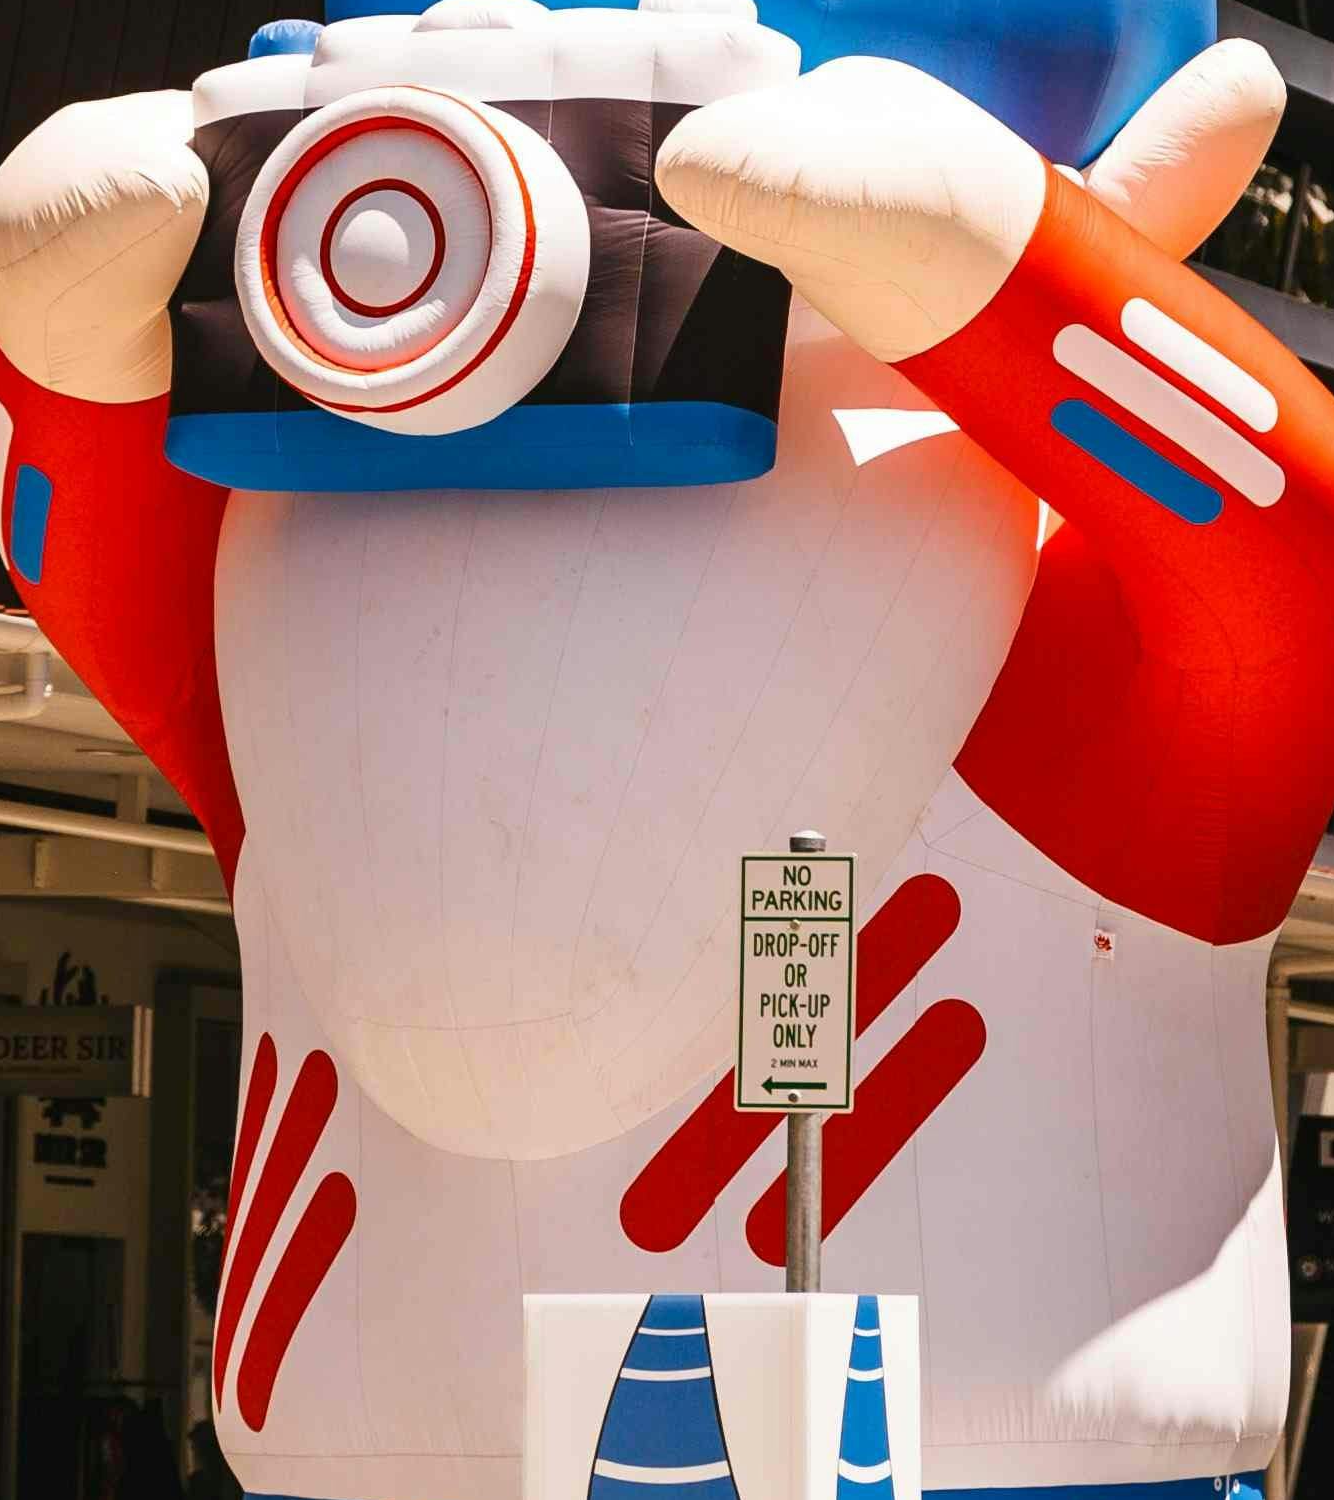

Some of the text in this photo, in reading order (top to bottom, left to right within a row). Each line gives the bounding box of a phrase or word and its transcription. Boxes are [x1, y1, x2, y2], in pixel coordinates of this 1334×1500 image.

[783, 865, 811, 886] NO
[752, 890, 842, 911] PARKING
[753, 933, 840, 957] DROP-OFF
[784, 963, 807, 987] OR
[760, 993, 830, 1018] PICK-UP
[76, 1035, 126, 1061] SIR
[773, 1024, 817, 1048] ONLY
[771, 1058, 818, 1068] 2 MIN MAX
